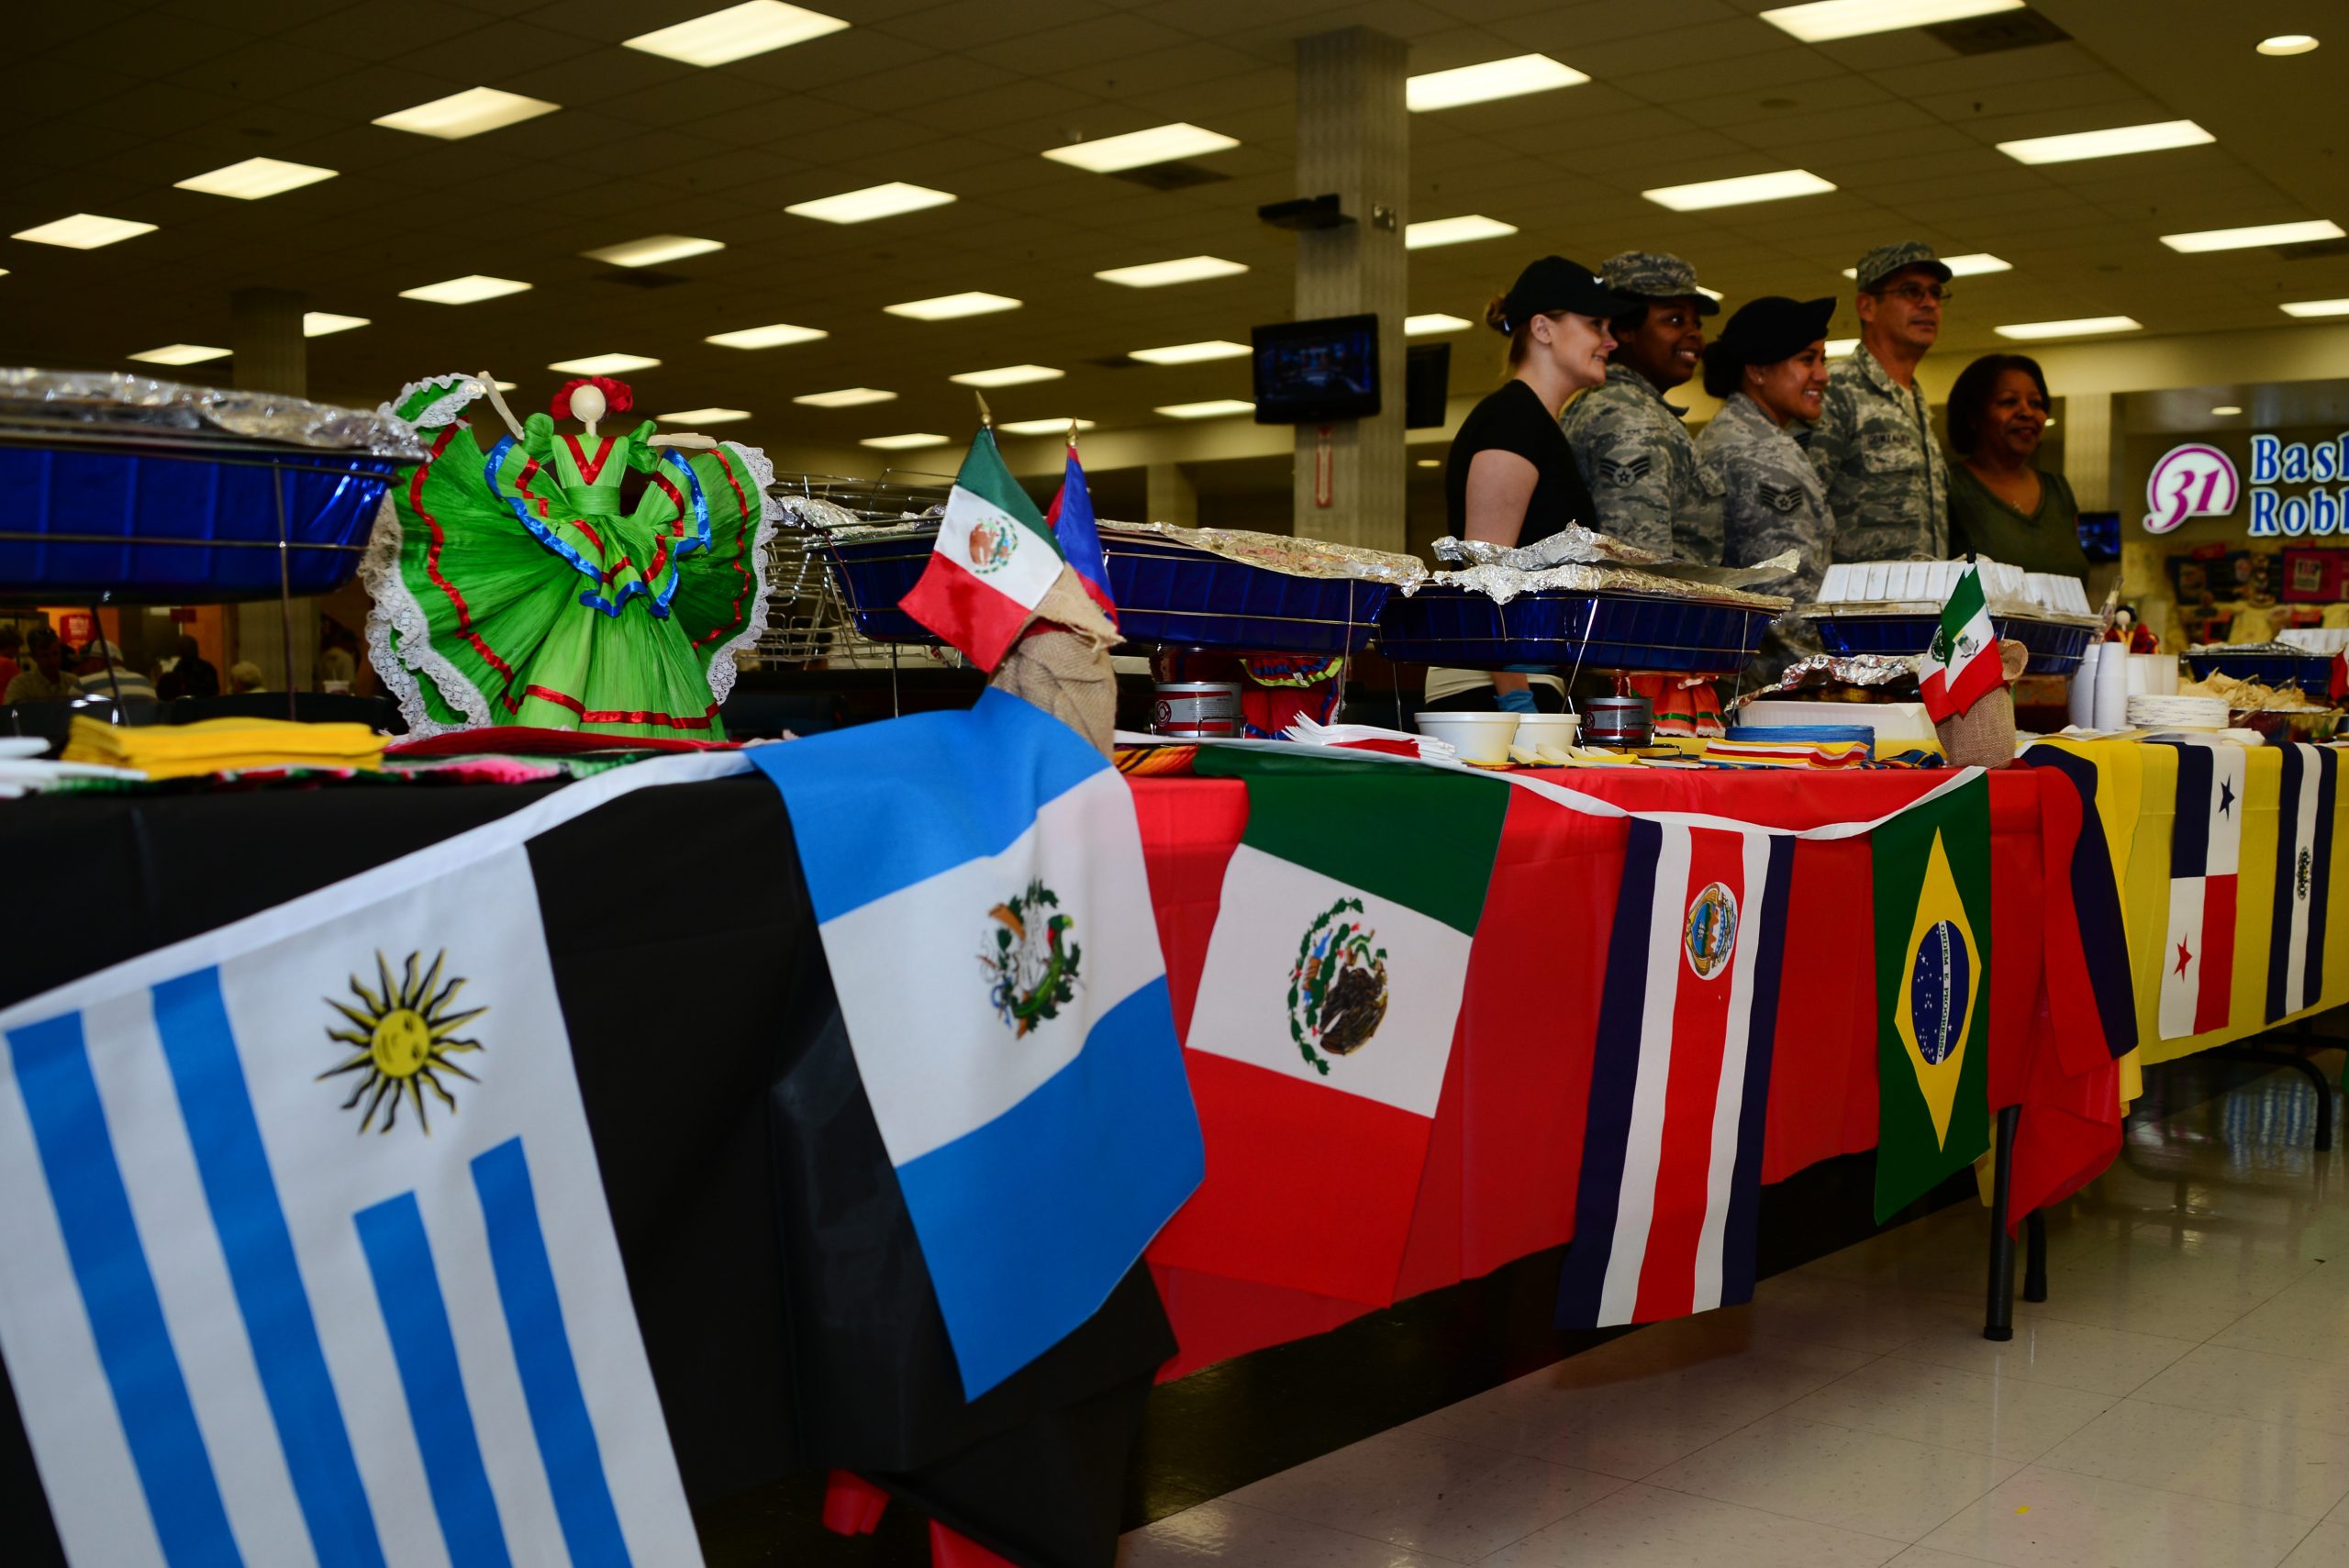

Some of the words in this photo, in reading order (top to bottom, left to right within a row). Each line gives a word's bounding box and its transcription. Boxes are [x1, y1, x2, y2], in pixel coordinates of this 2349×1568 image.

[2147, 469, 2221, 529] 31
[1940, 924, 1949, 966] ORDEM
[1944, 973, 1949, 981] E
[1938, 987, 1949, 1058] PROGRESSO
